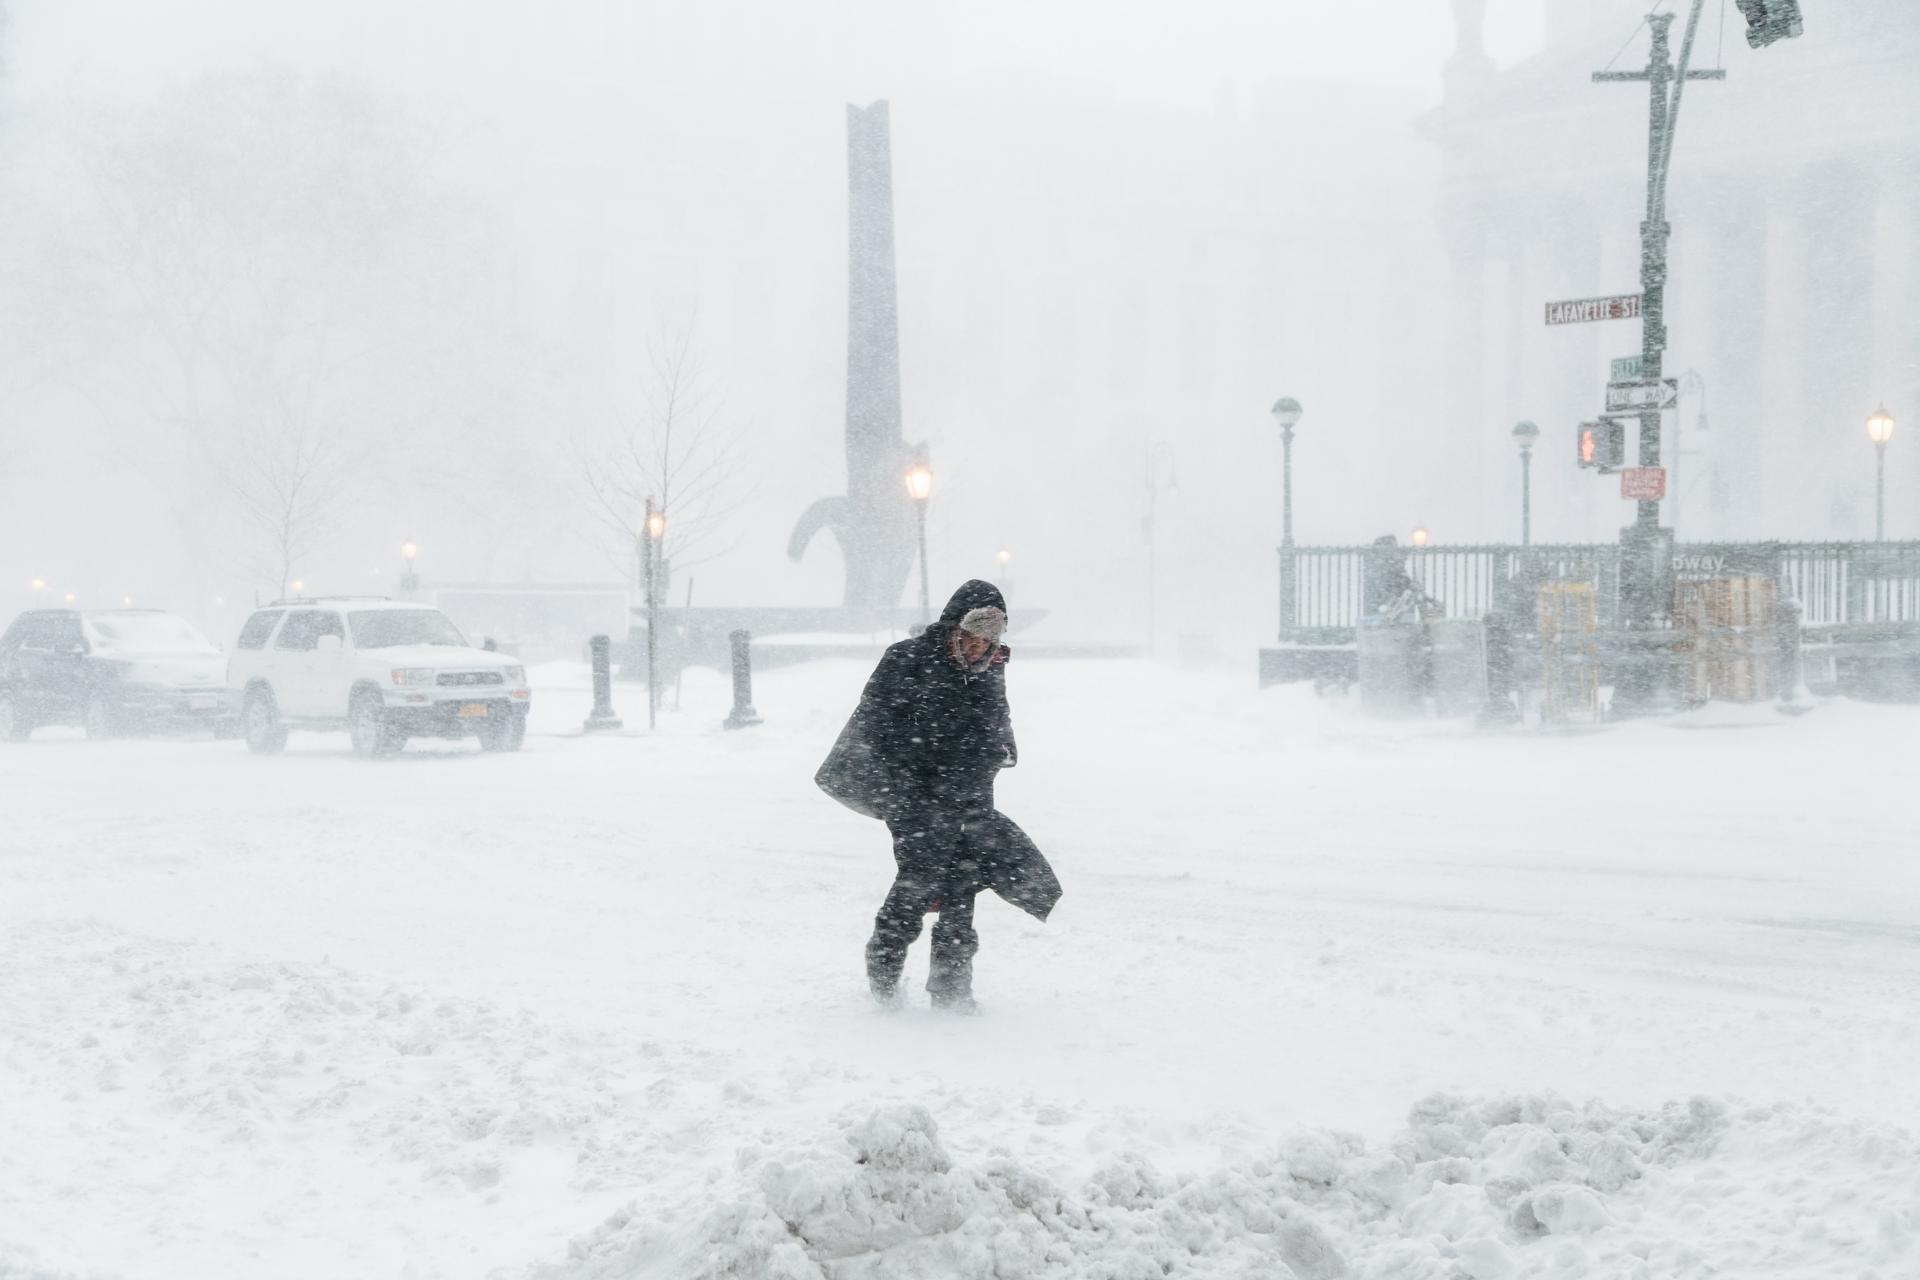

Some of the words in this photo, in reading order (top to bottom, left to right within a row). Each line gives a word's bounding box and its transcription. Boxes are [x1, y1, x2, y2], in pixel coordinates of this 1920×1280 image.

[1550, 301, 1613, 322] LAFAYETTE
[1622, 297, 1639, 318] ST
[1611, 389, 1631, 403] ONE
[1645, 387, 1666, 401] WAY
